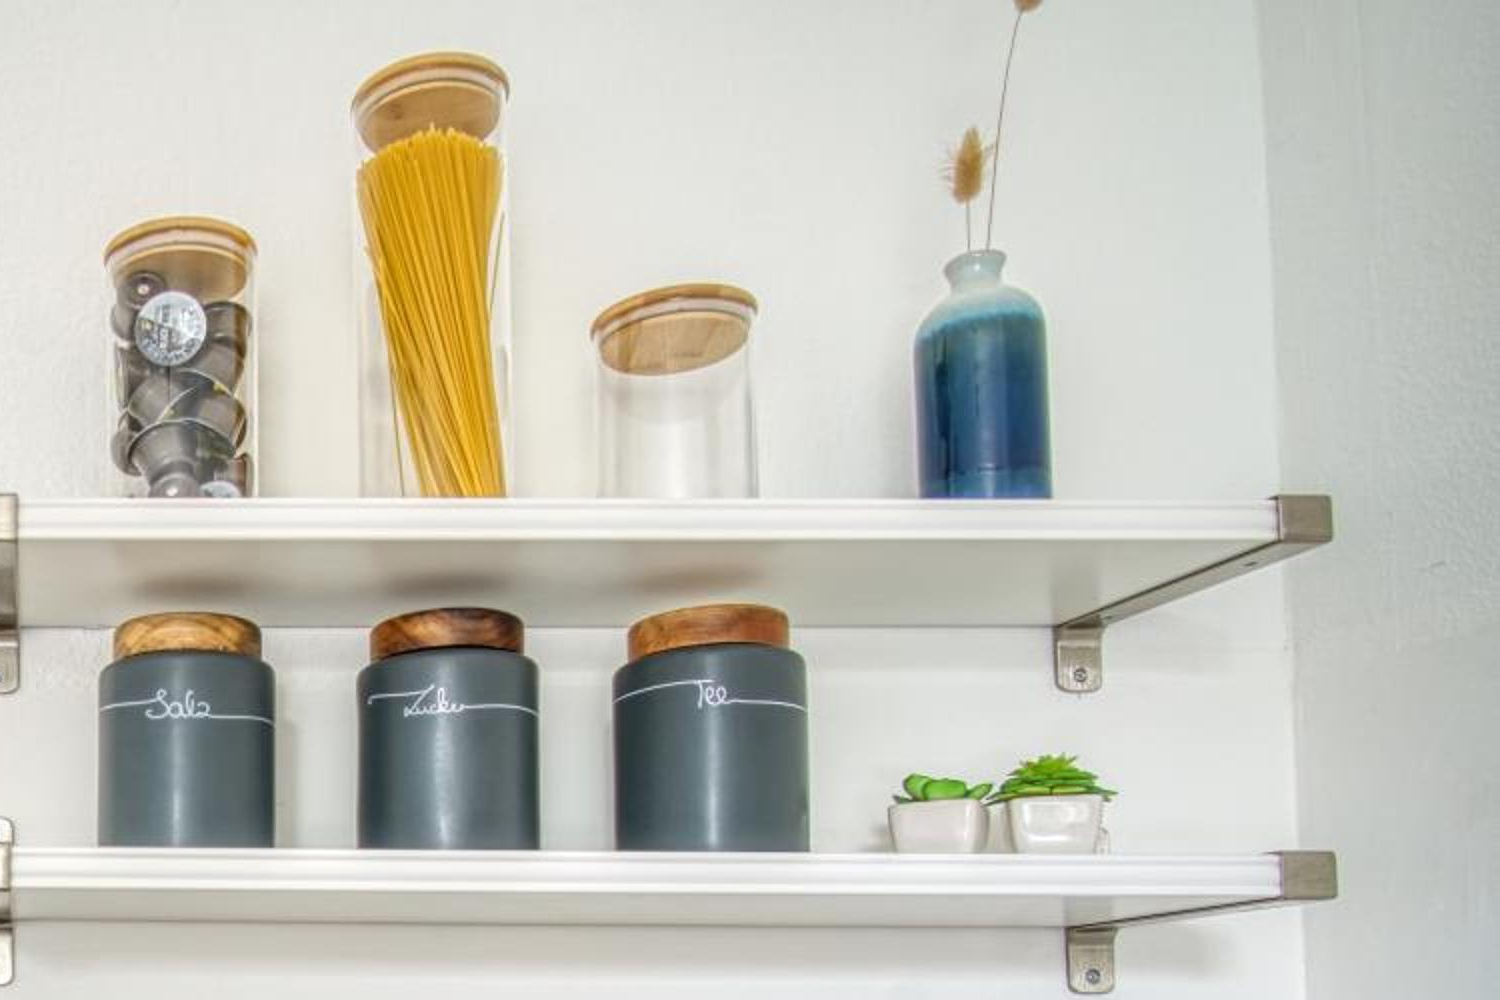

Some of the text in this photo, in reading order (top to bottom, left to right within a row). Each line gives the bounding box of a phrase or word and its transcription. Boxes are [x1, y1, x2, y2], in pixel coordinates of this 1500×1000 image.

[145, 688, 211, 719] Salz
[403, 684, 465, 717] Zucker
[693, 679, 729, 709] Tee
